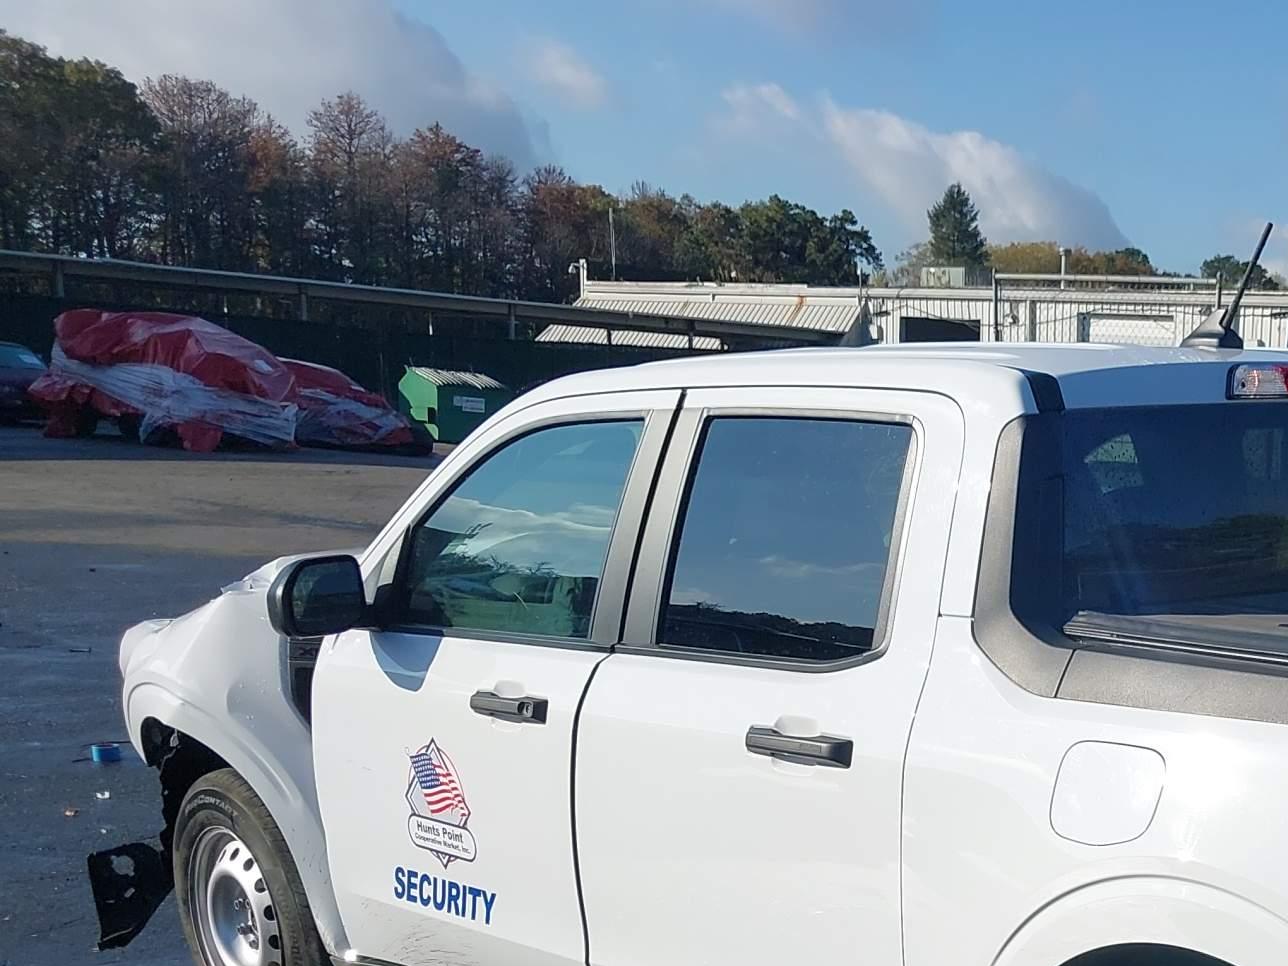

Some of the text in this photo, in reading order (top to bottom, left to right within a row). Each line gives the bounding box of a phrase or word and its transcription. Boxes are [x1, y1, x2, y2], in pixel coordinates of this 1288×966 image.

[416, 820, 464, 844] Hunts Point
[394, 866, 497, 925] SECURITY
